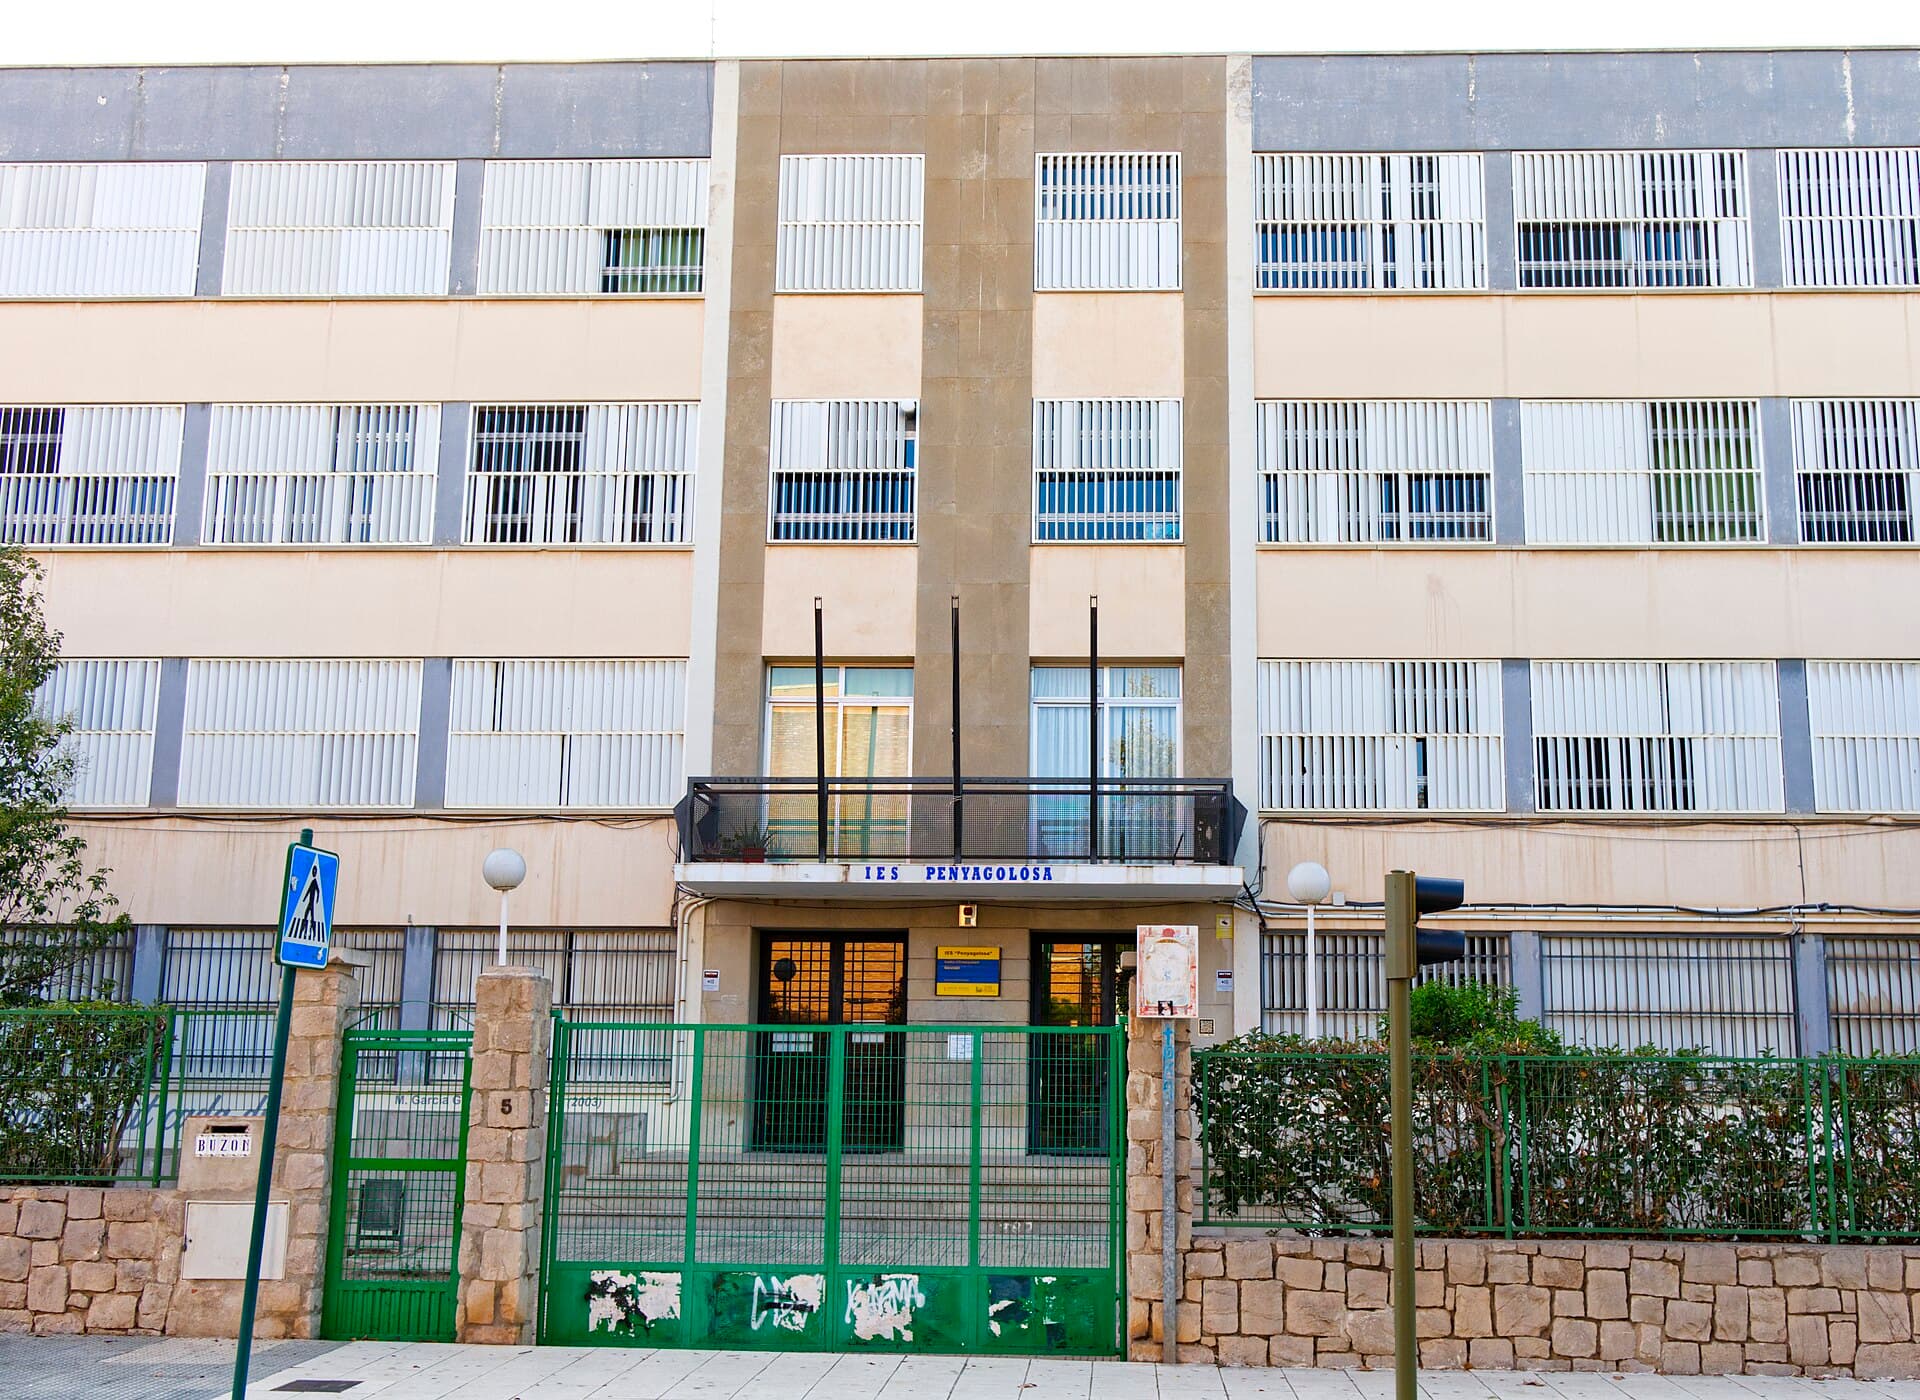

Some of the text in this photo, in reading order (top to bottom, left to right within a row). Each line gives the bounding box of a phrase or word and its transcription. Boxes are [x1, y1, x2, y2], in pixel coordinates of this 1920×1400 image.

[865, 866, 1052, 881] IES PENYAGOLOSA
[500, 1098, 513, 1115] 5
